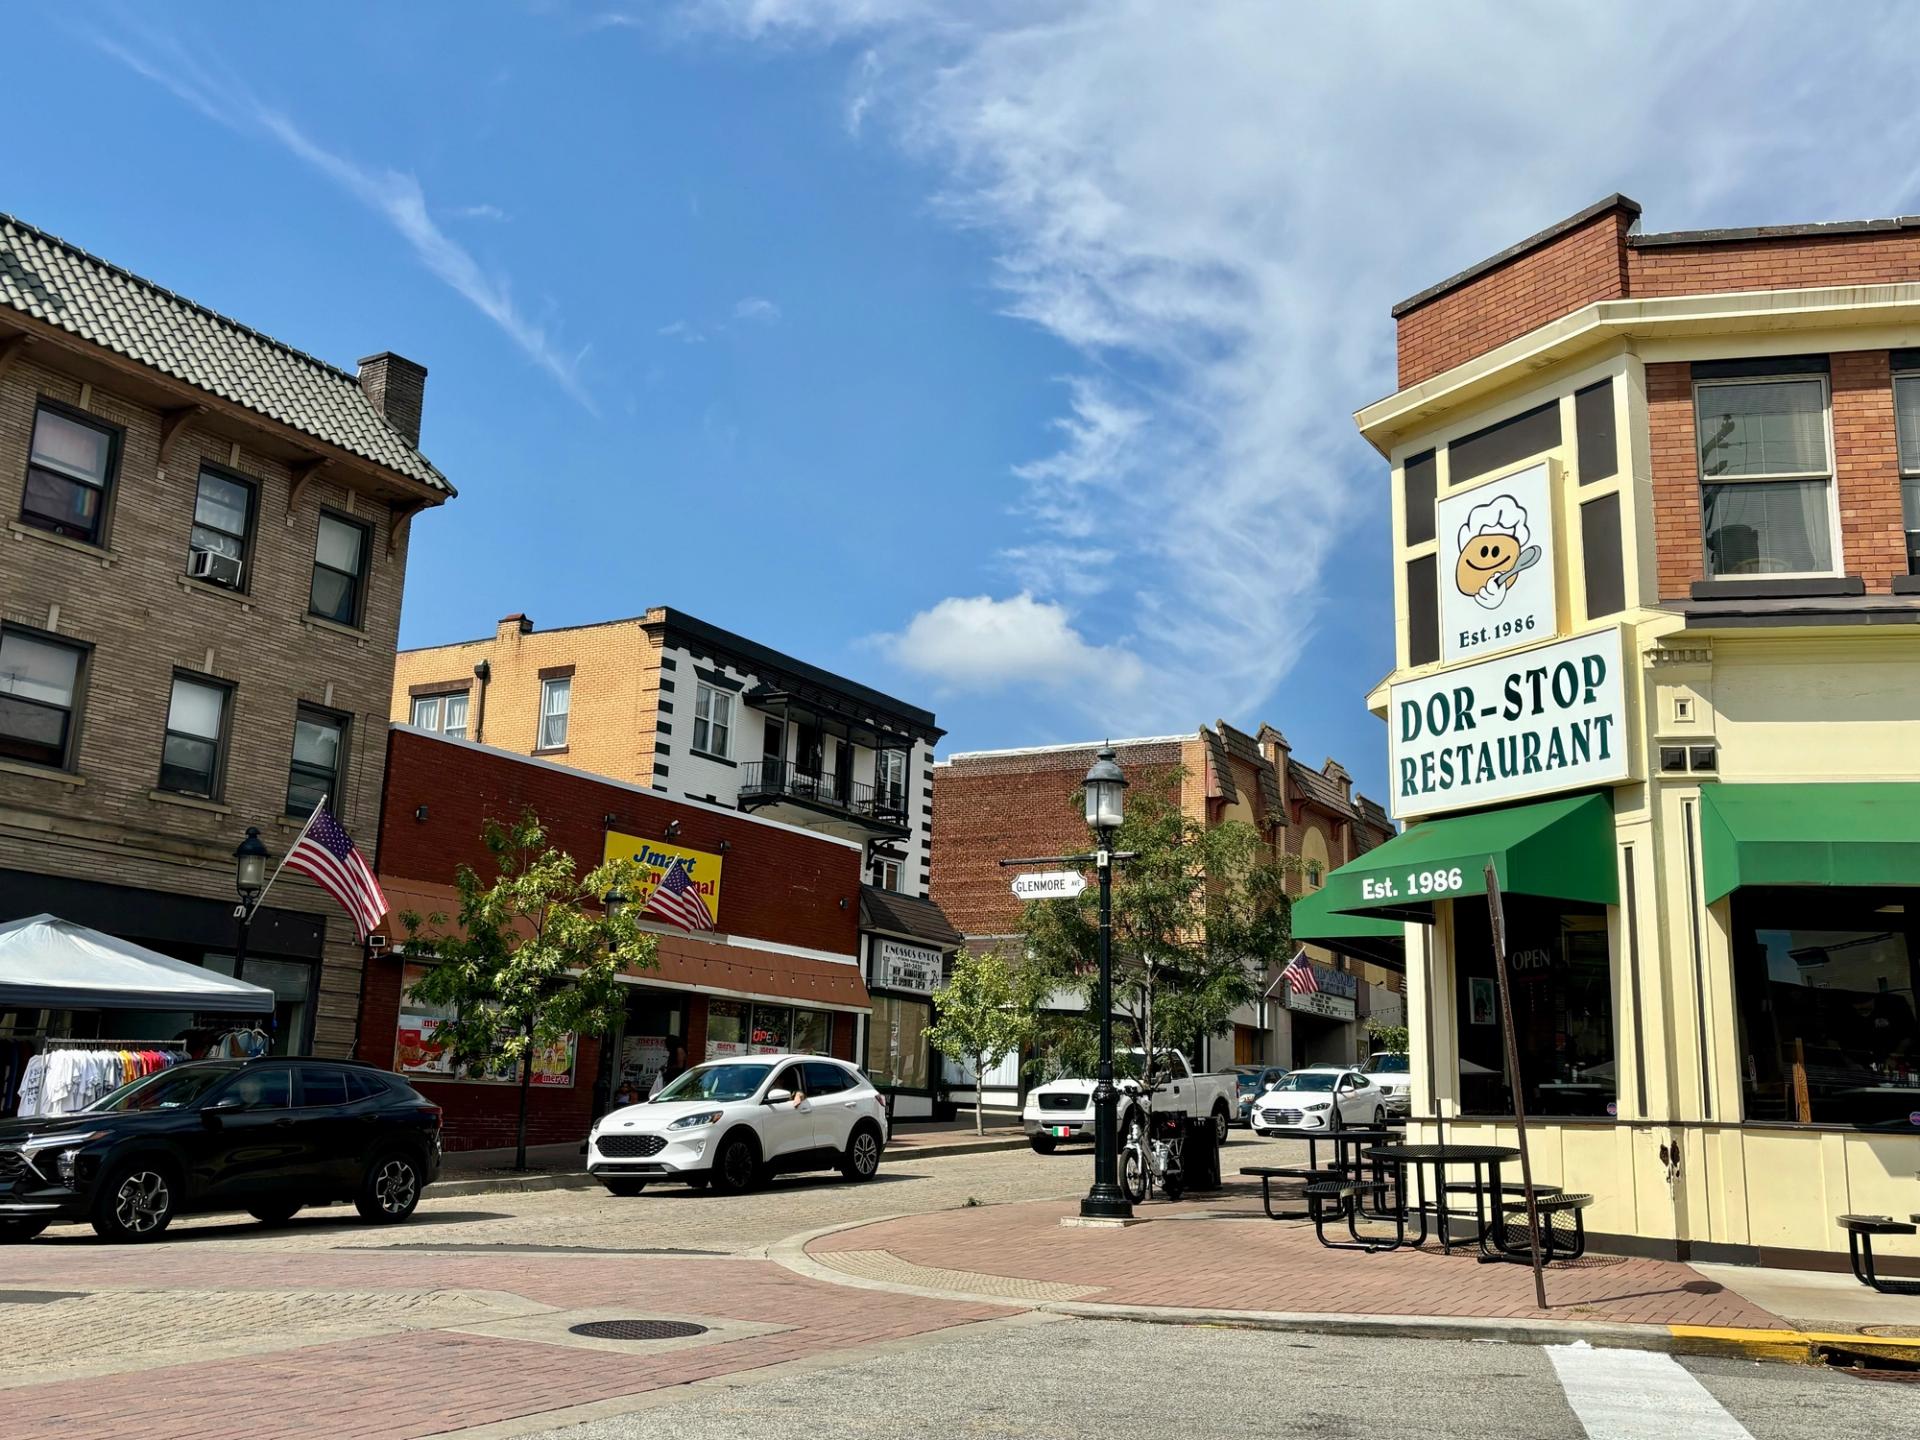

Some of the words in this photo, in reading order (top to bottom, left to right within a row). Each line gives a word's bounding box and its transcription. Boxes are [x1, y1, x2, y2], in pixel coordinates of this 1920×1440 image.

[1400, 653, 1608, 743] DOR-STOP
[1400, 713, 1615, 797] RESTAURANT
[1016, 879, 1066, 892] GLENMORE
[1362, 876, 1399, 900] Est.
[1407, 867, 1464, 896] 1986
[1512, 947, 1551, 970] OPEN
[752, 1030, 780, 1043] OPEN
[543, 1074, 569, 1085] merve
